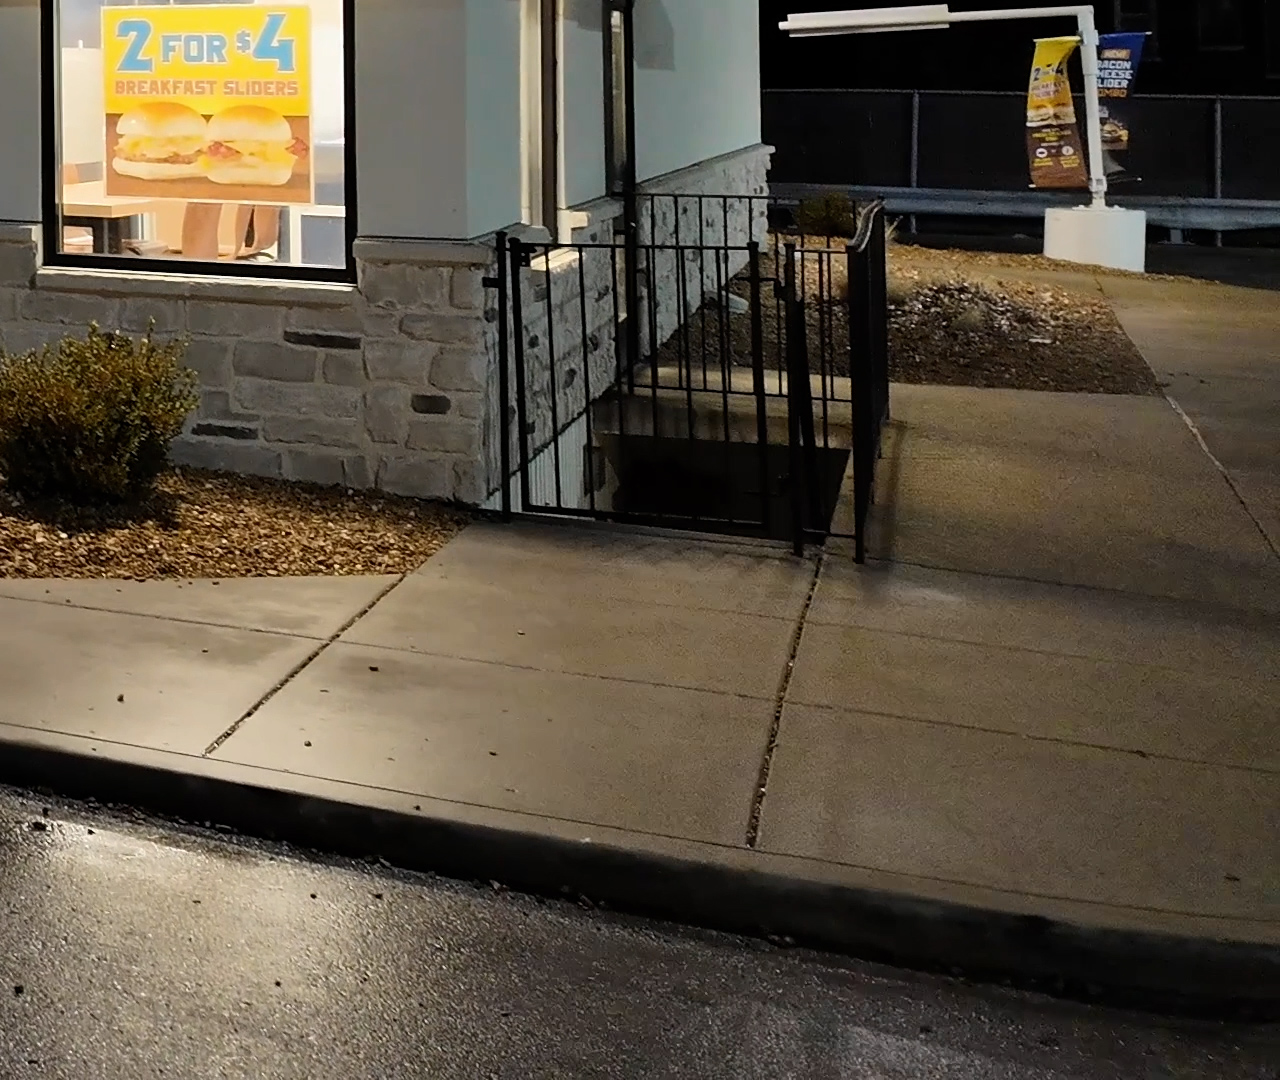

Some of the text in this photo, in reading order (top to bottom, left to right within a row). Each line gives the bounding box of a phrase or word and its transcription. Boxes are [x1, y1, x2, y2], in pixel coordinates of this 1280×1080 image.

[115, 12, 296, 73] 2 FOR $4
[1097, 70, 1133, 79] HEESE
[115, 80, 299, 96] BREAKFAST SLIDERS
[1097, 88, 1128, 98] OMBO
